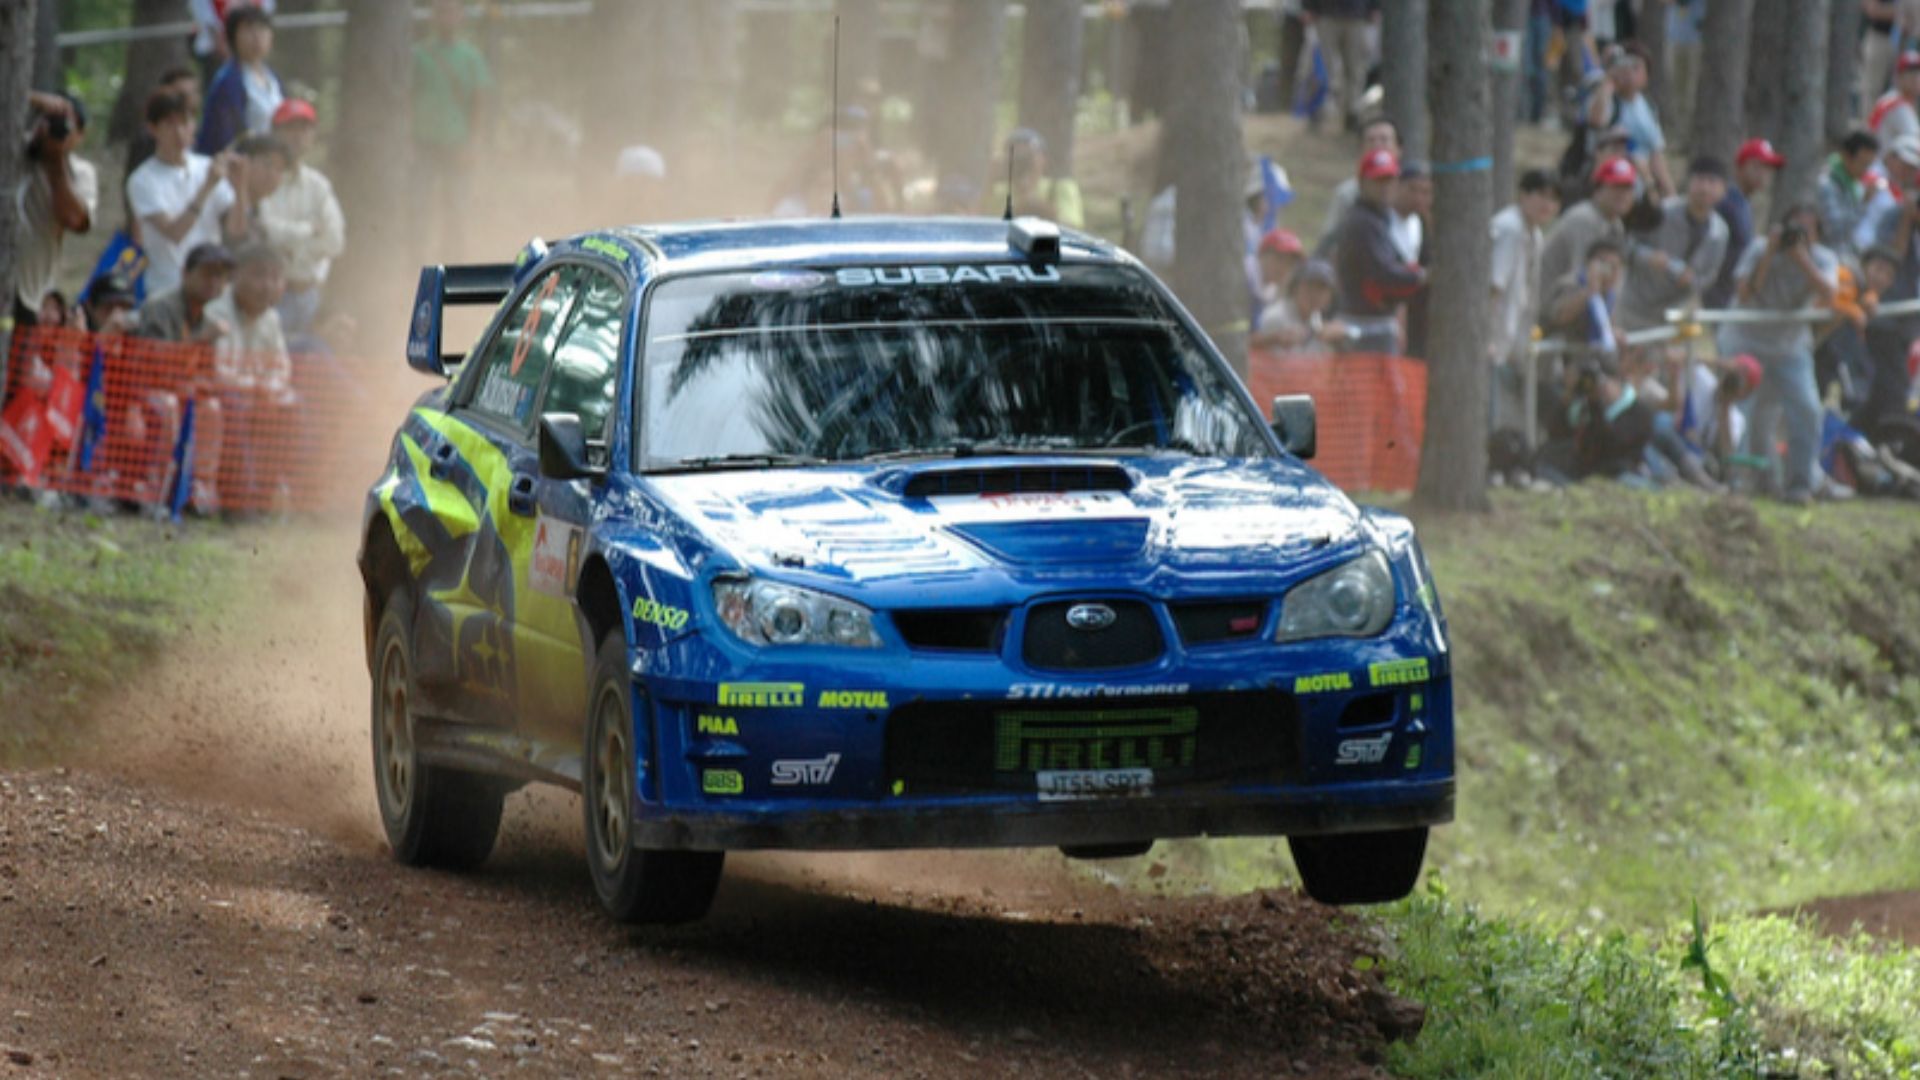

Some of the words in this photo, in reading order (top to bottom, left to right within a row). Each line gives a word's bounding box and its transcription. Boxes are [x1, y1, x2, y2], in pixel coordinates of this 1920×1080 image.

[837, 264, 1061, 286] SUBARU
[633, 597, 688, 629] DENSO
[1368, 657, 1430, 686] PIRELLI
[1006, 683, 1056, 699] STI
[1294, 672, 1353, 694] MOTUL
[718, 682, 804, 707] PIRELLI
[818, 691, 889, 709] MOTUL
[698, 715, 739, 734] PIAA
[993, 707, 1198, 771] PIRELLI
